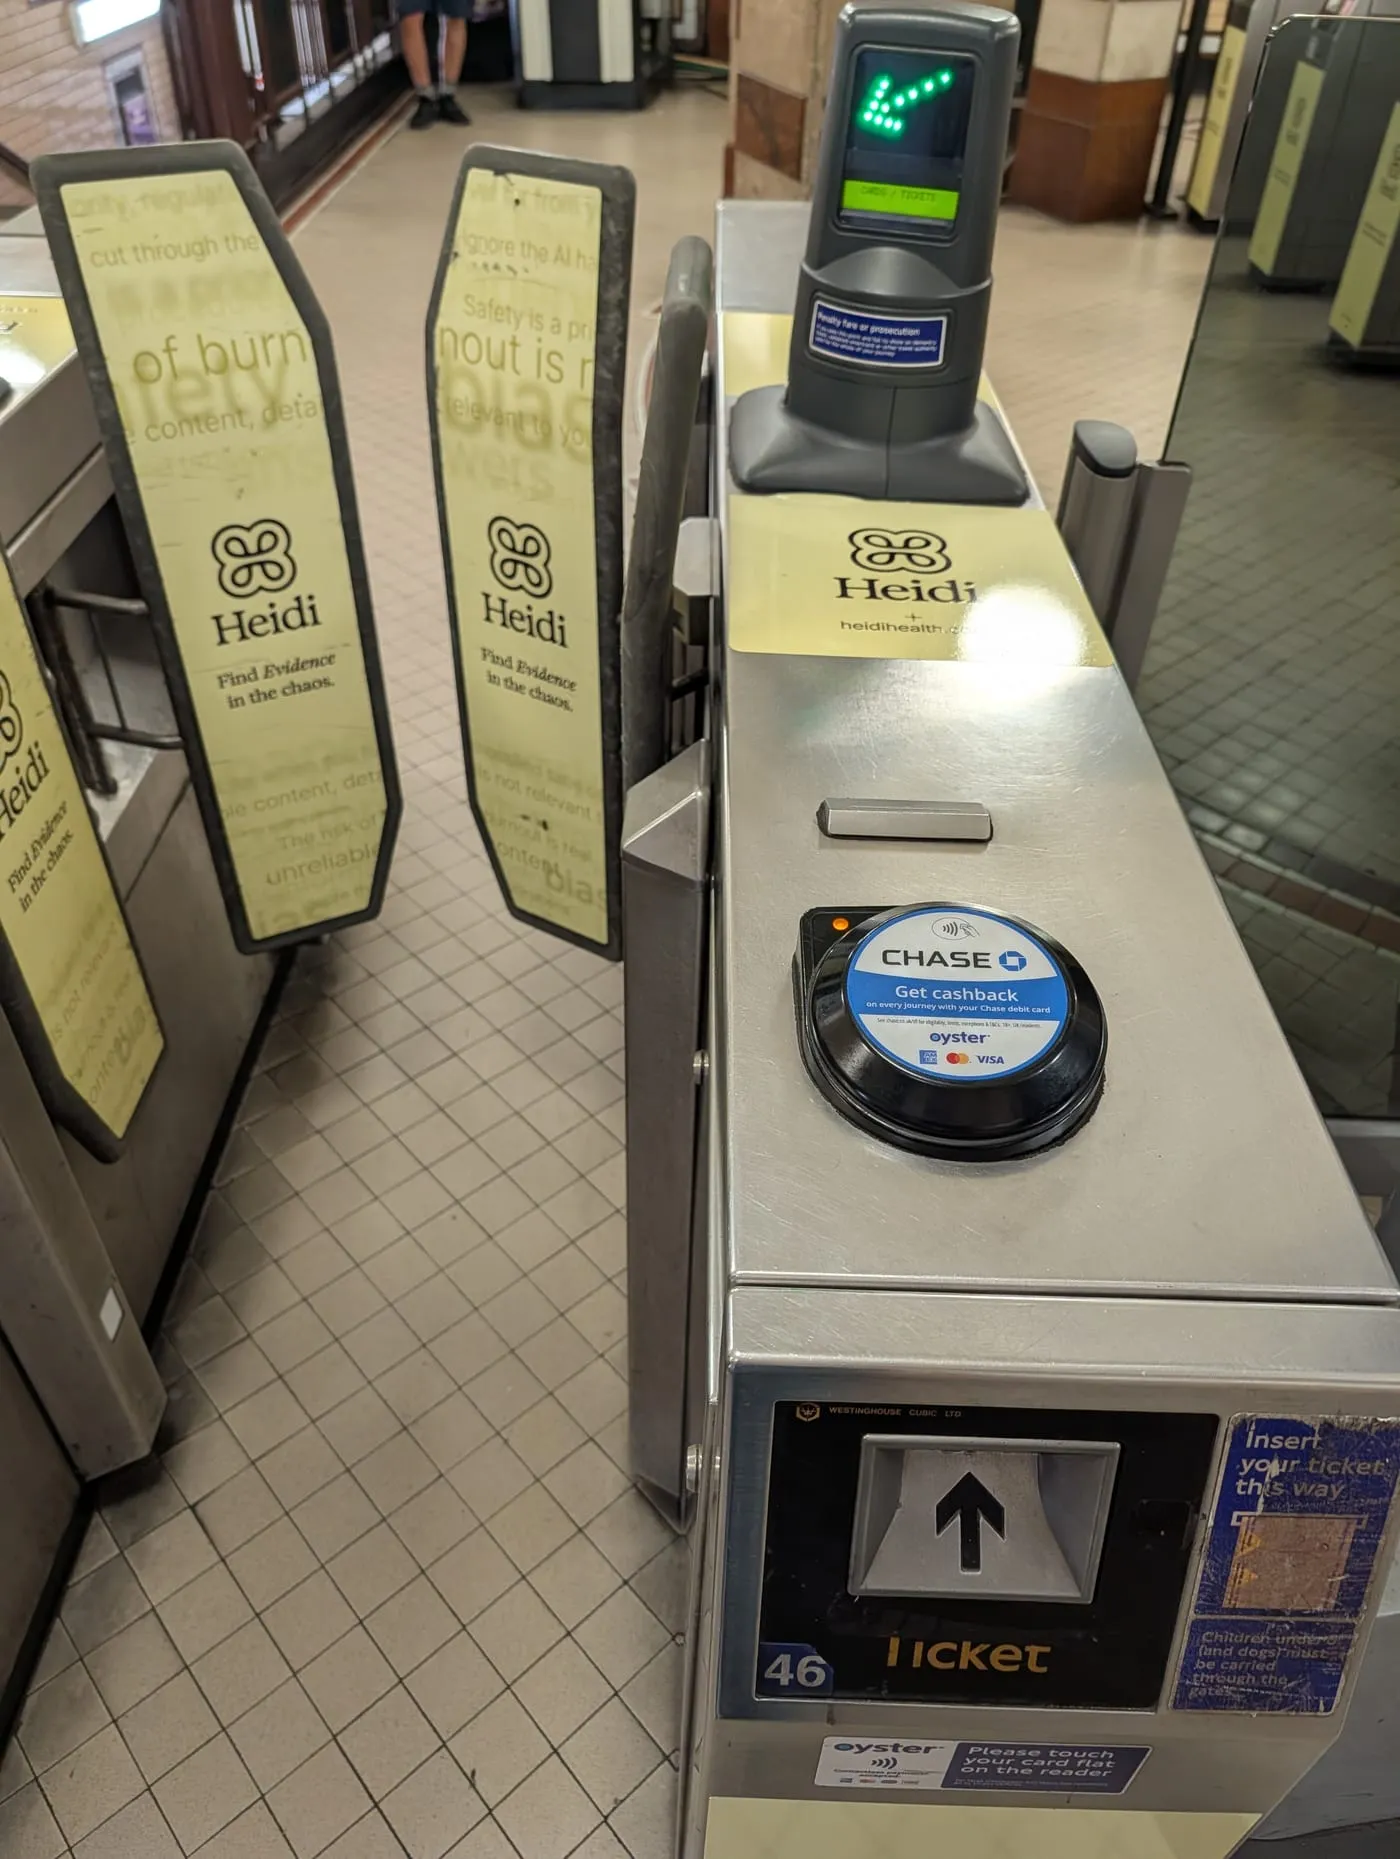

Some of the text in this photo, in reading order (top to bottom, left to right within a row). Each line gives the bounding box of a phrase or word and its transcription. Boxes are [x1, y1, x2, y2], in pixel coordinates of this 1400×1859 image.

[89, 232, 261, 269] cut through the
[463, 294, 524, 332] Safety
[529, 305, 544, 331] is
[550, 320, 561, 335] a
[859, 323, 869, 332] or
[870, 324, 920, 337] prosecution
[132, 326, 309, 385] of burn
[438, 325, 521, 377] nout
[535, 338, 565, 385] is
[144, 408, 255, 444] content,
[833, 577, 977, 603] Heidi
[211, 593, 324, 647] Heidi
[481, 592, 570, 649] Heidi
[217, 650, 337, 690] Find Evidence
[480, 646, 579, 693] Find Evidence
[227, 676, 336, 710] in the chaos.
[487, 670, 575, 712] in the chaos.
[253, 780, 338, 813] content,
[525, 785, 592, 821] relevant
[7, 801, 69, 894] Find Evidence
[19, 894, 33, 915] in
[29, 869, 49, 899] the
[882, 949, 992, 969] CHASE
[895, 985, 1019, 1002] Get cashback
[879, 1002, 902, 1010] every
[903, 1002, 937, 1011] journey
[938, 1003, 957, 1011] with
[958, 1005, 978, 1013] your
[1007, 1005, 1030, 1013] debit
[1031, 1006, 1051, 1014] card
[929, 1031, 987, 1046] oyster
[976, 1055, 1005, 1065] VISA
[828, 1406, 962, 1418] WESTINGHOUSE CUBIC LTD
[1246, 1425, 1322, 1449] Insert
[1239, 1456, 1385, 1477] your ticket
[1235, 1477, 1345, 1501] this way
[1202, 1631, 1270, 1644] Children
[764, 1652, 827, 1689] 46
[1194, 1659, 1277, 1672] be carried
[1192, 1672, 1289, 1686] through the
[833, 1743, 938, 1755] oyster
[968, 1746, 1115, 1759] Please touch
[960, 1766, 1113, 1778] on the reader
[963, 1756, 1116, 1769] your card flat
